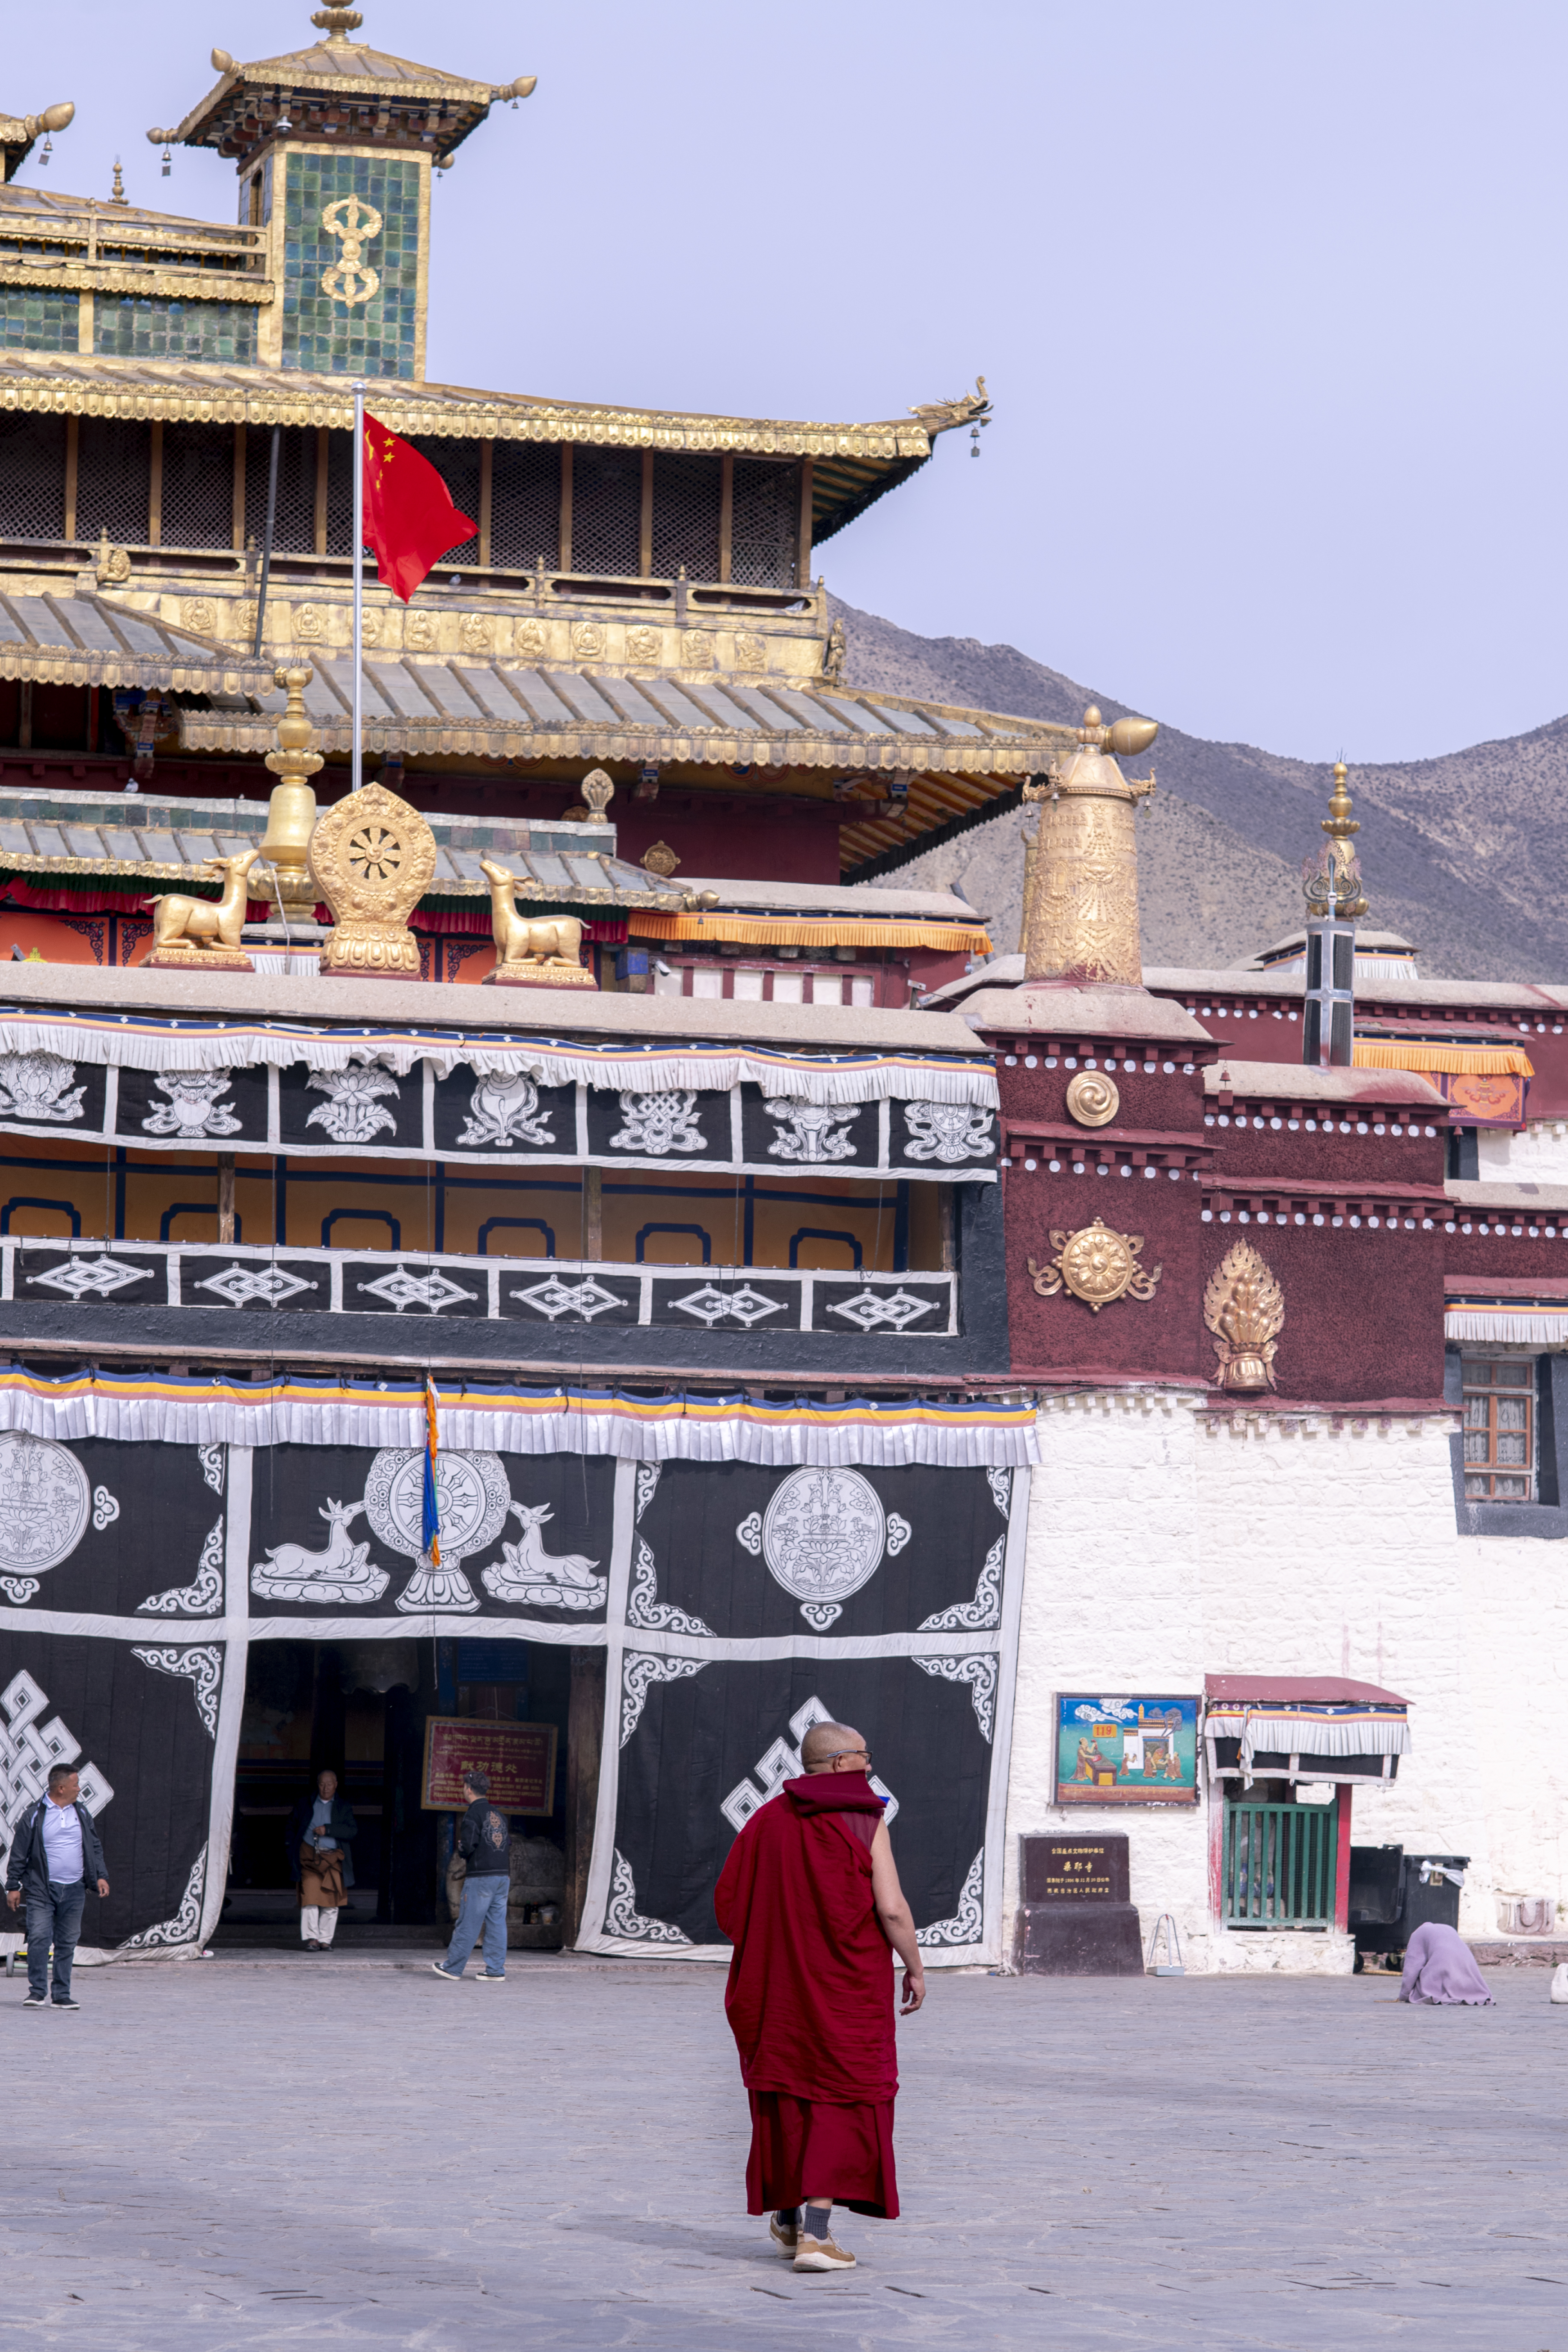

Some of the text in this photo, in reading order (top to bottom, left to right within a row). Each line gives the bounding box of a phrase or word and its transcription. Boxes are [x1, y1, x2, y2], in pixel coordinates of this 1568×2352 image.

[1096, 1725, 1112, 1736] 119
[460, 1760, 517, 1773] 献功德处
[1063, 1861, 1093, 1873] 桑耶寺
